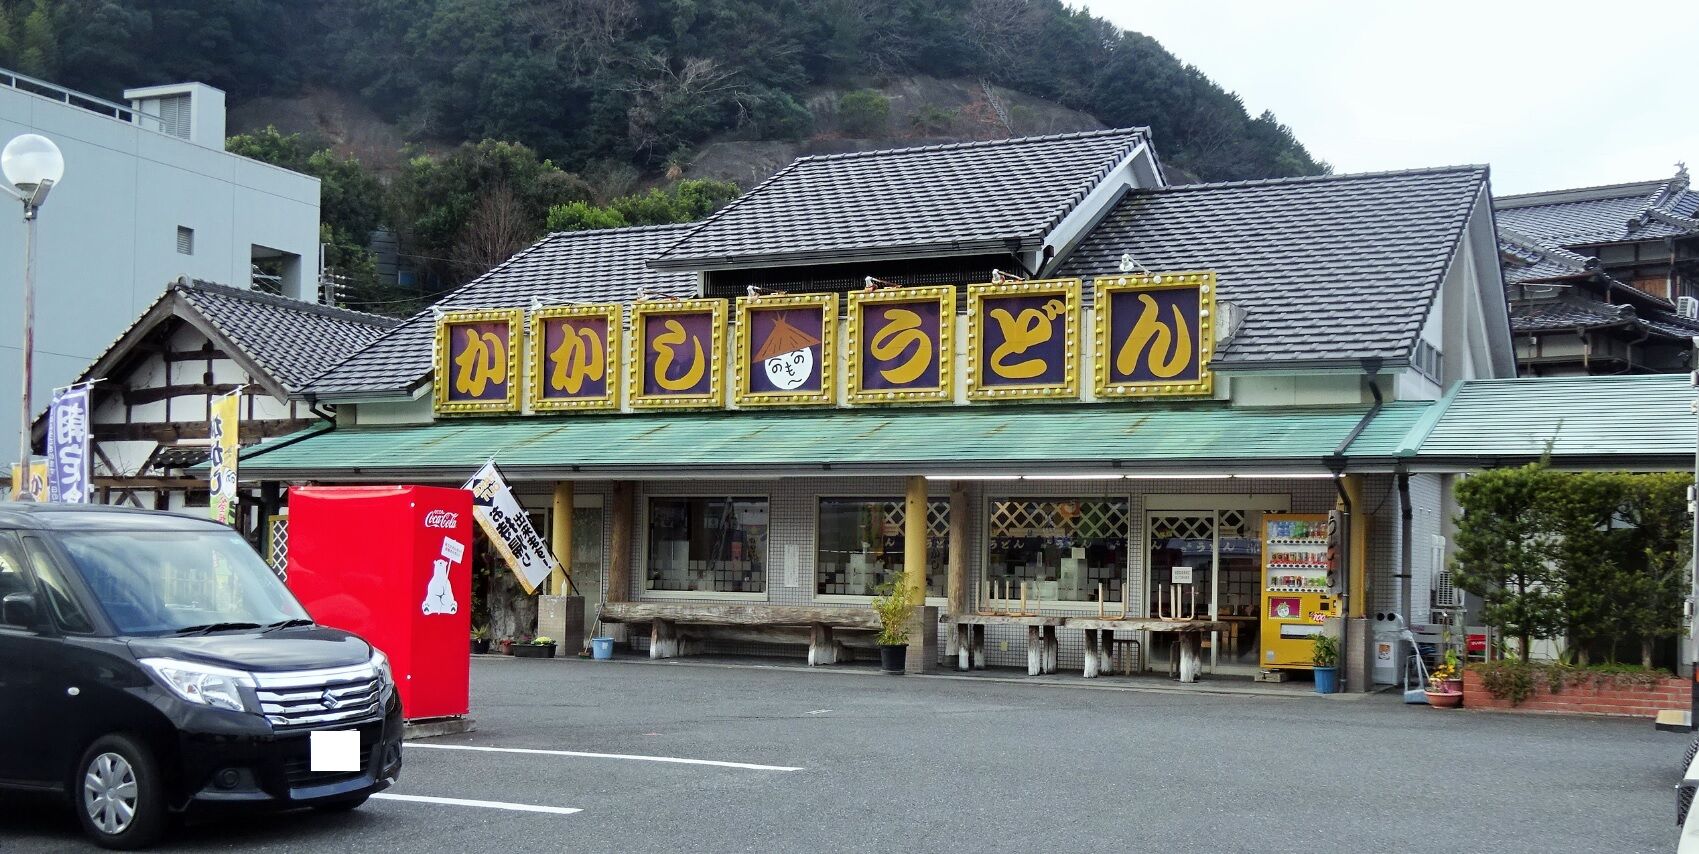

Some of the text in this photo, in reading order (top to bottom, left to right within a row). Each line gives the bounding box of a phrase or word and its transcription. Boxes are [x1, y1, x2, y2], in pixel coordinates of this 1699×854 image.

[870, 293, 1191, 384] うどん
[425, 510, 459, 528] Coca-Cola
